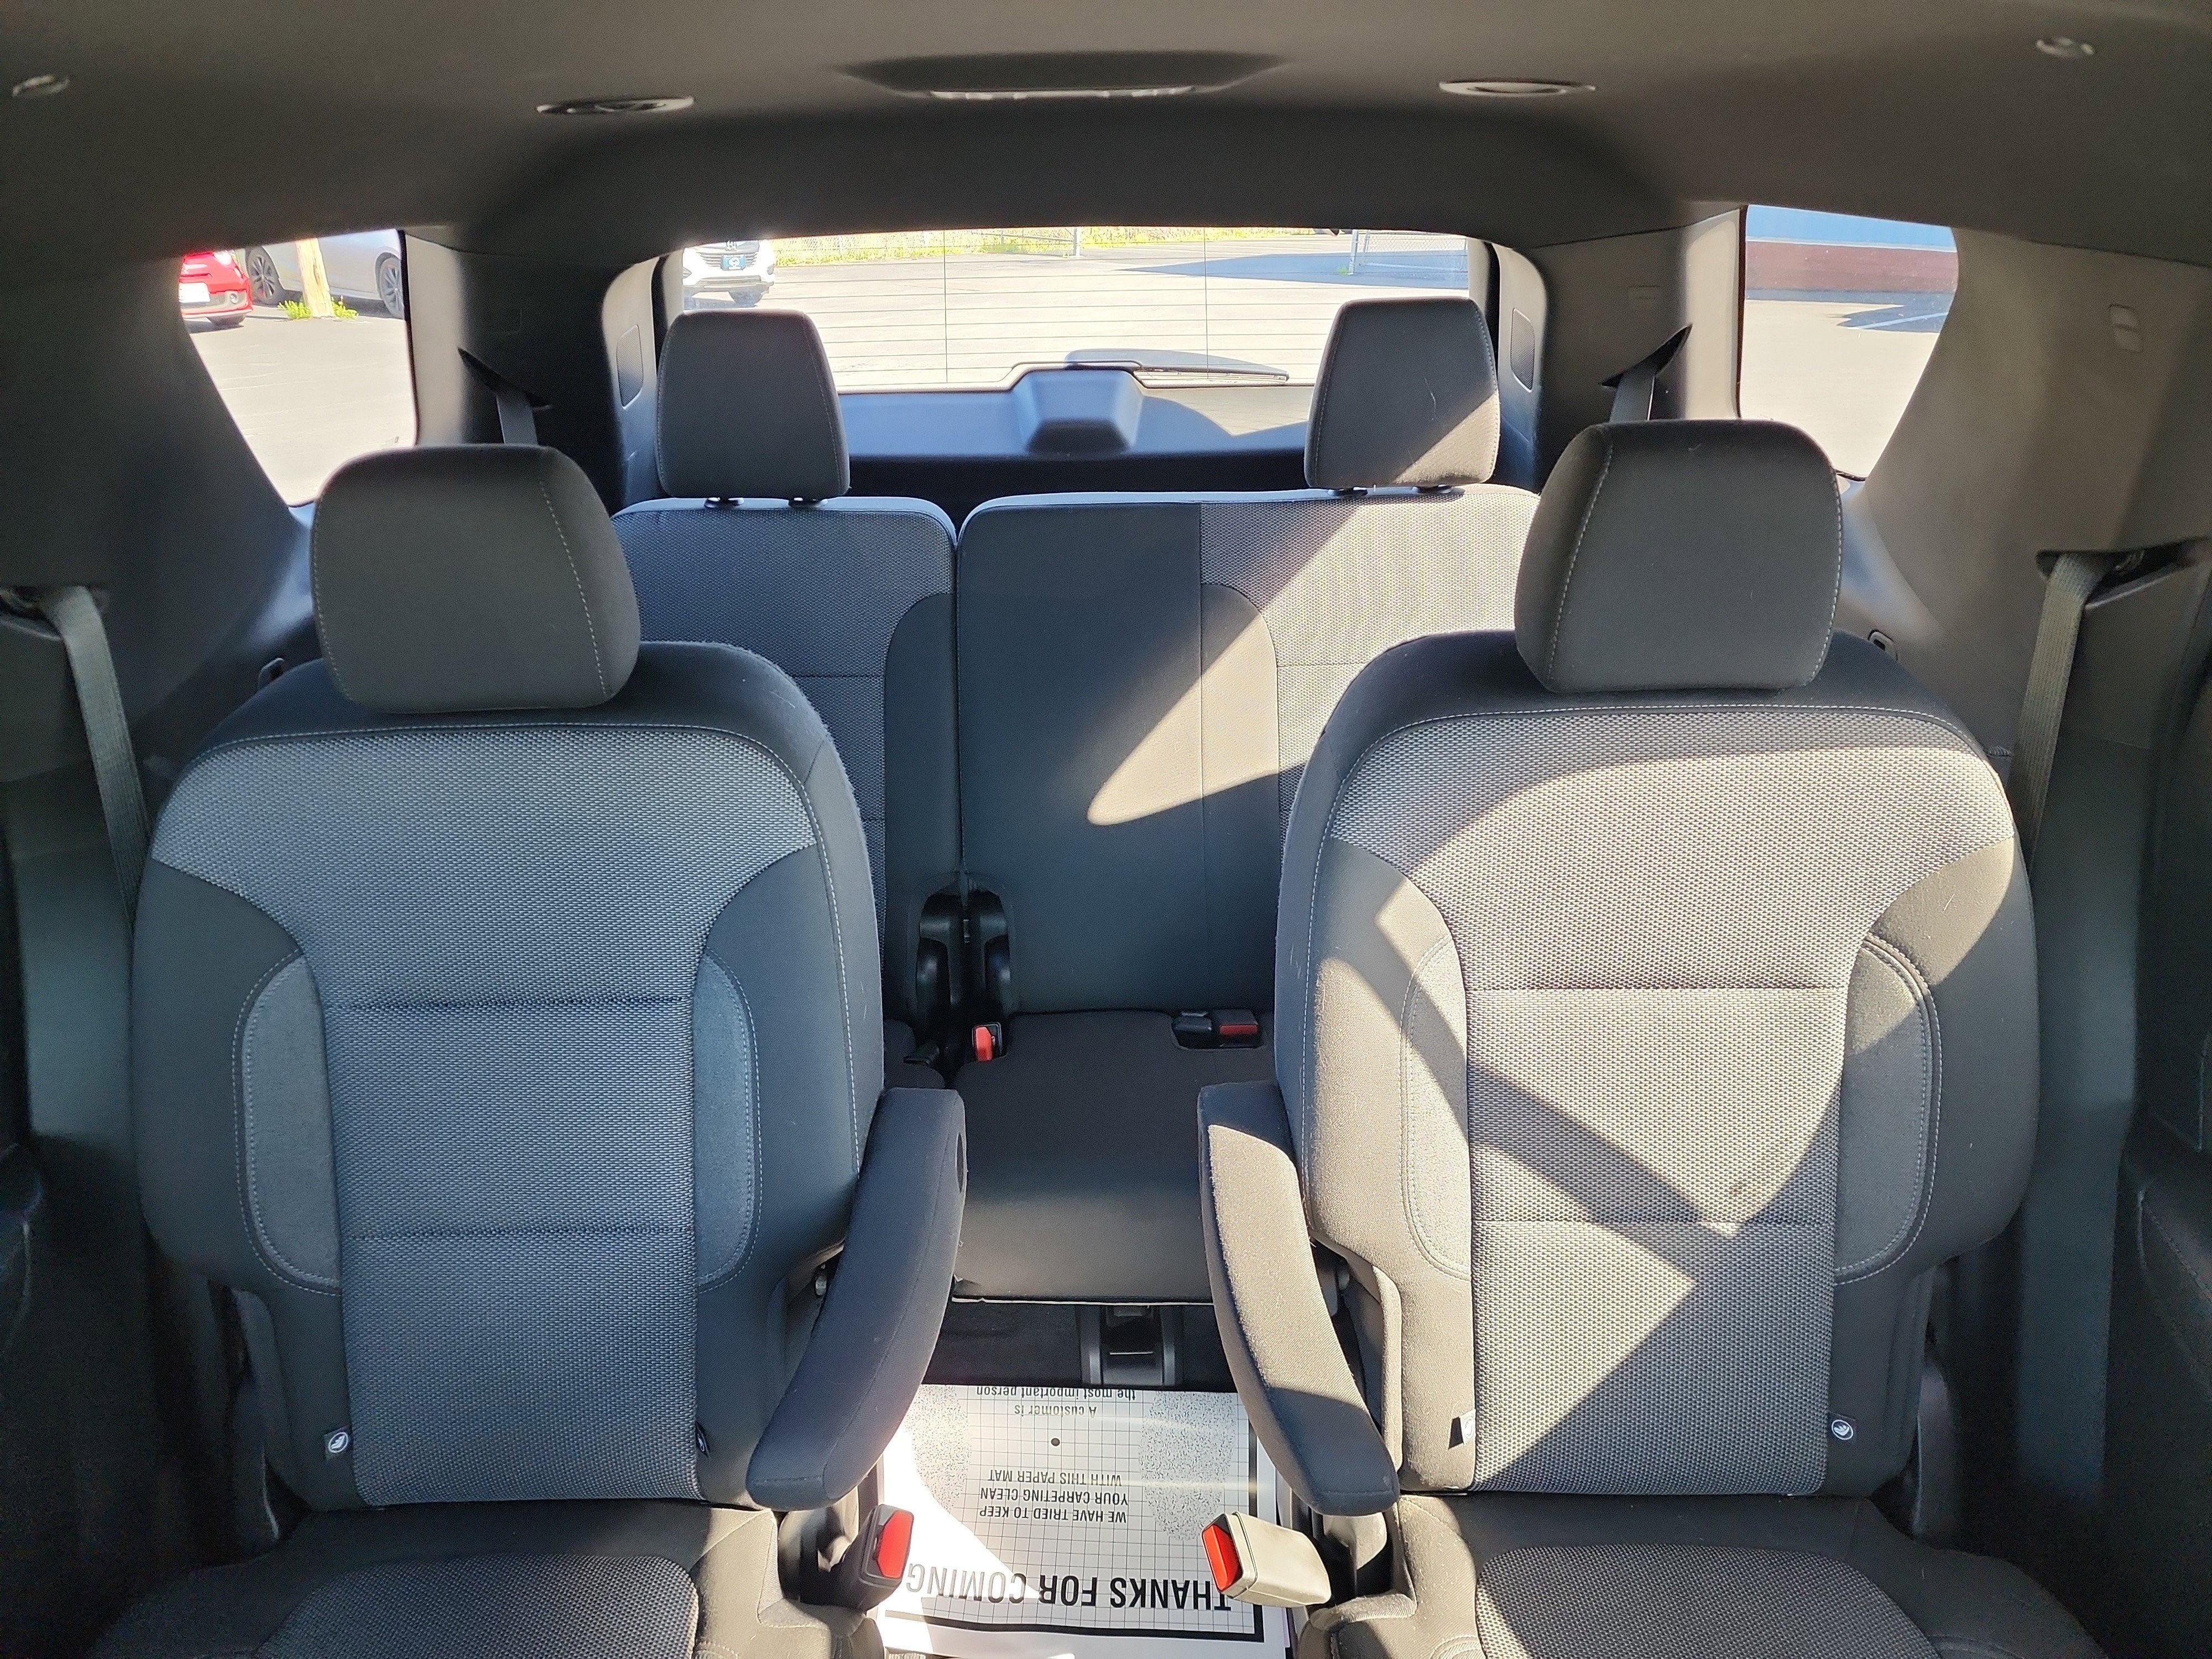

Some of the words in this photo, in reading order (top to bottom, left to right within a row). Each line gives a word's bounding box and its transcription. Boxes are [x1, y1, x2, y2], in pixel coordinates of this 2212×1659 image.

[977, 1386, 1016, 1396] person
[1021, 1387, 1079, 1400] important
[1083, 1389, 1113, 1400] most
[1118, 1390, 1136, 1401] the
[1014, 1405, 1024, 1417] is
[1029, 1405, 1084, 1417] customer
[1088, 1406, 1097, 1418] A
[988, 1469, 1013, 1482] MAT
[1018, 1470, 1055, 1484] PAPER
[1060, 1472, 1087, 1485] THIS
[1091, 1474, 1122, 1486] WITH
[980, 1487, 1018, 1501] CLEAN
[1023, 1489, 1090, 1504] CARPETING
[1095, 1492, 1128, 1505] YOUR
[979, 1505, 1009, 1517] KEEP
[1014, 1506, 1029, 1519] TO
[1033, 1507, 1068, 1521] TRIED
[1072, 1509, 1103, 1522] HAVE
[1108, 1511, 1127, 1523] WE
[906, 1563, 1026, 1604] COMING
[1039, 1574, 1098, 1606] FOR
[1110, 1577, 1231, 1611] THANKS
